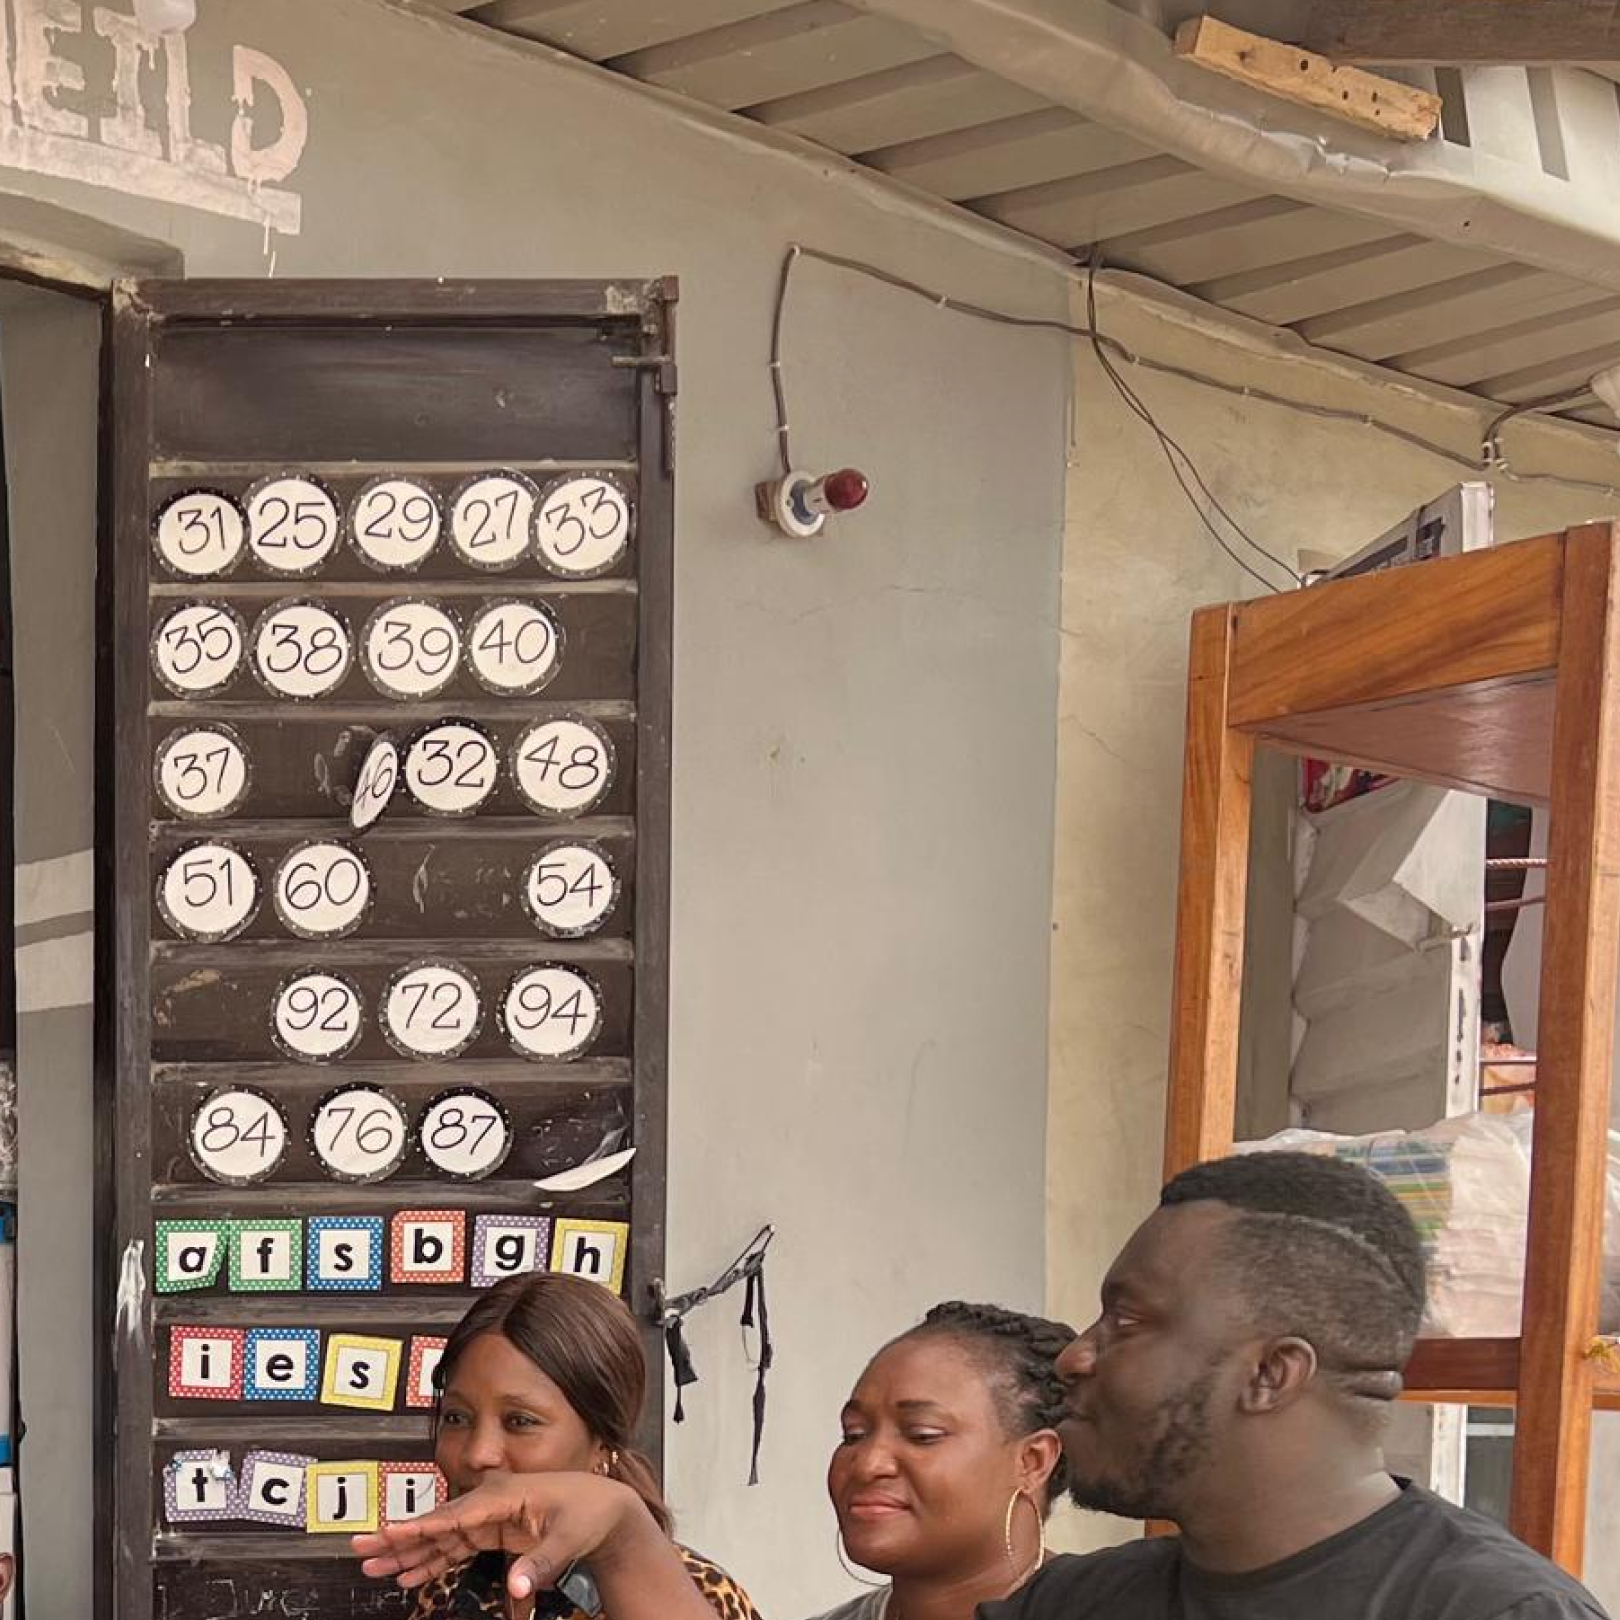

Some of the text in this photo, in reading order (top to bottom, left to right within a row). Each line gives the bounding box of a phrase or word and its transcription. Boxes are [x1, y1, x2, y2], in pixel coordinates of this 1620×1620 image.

[178, 487, 620, 553] 31 25 29 27 33
[165, 612, 548, 675] 35 38 39 40
[174, 737, 598, 801] 37 46 32 48
[185, 859, 602, 909] 51 60 54
[287, 983, 586, 1035] 92 72 94
[202, 1108, 496, 1156] 84 76 87
[180, 1229, 600, 1274] a f s b g h
[201, 1344, 370, 1389] i e s
[192, 1468, 415, 1520] t c j i
